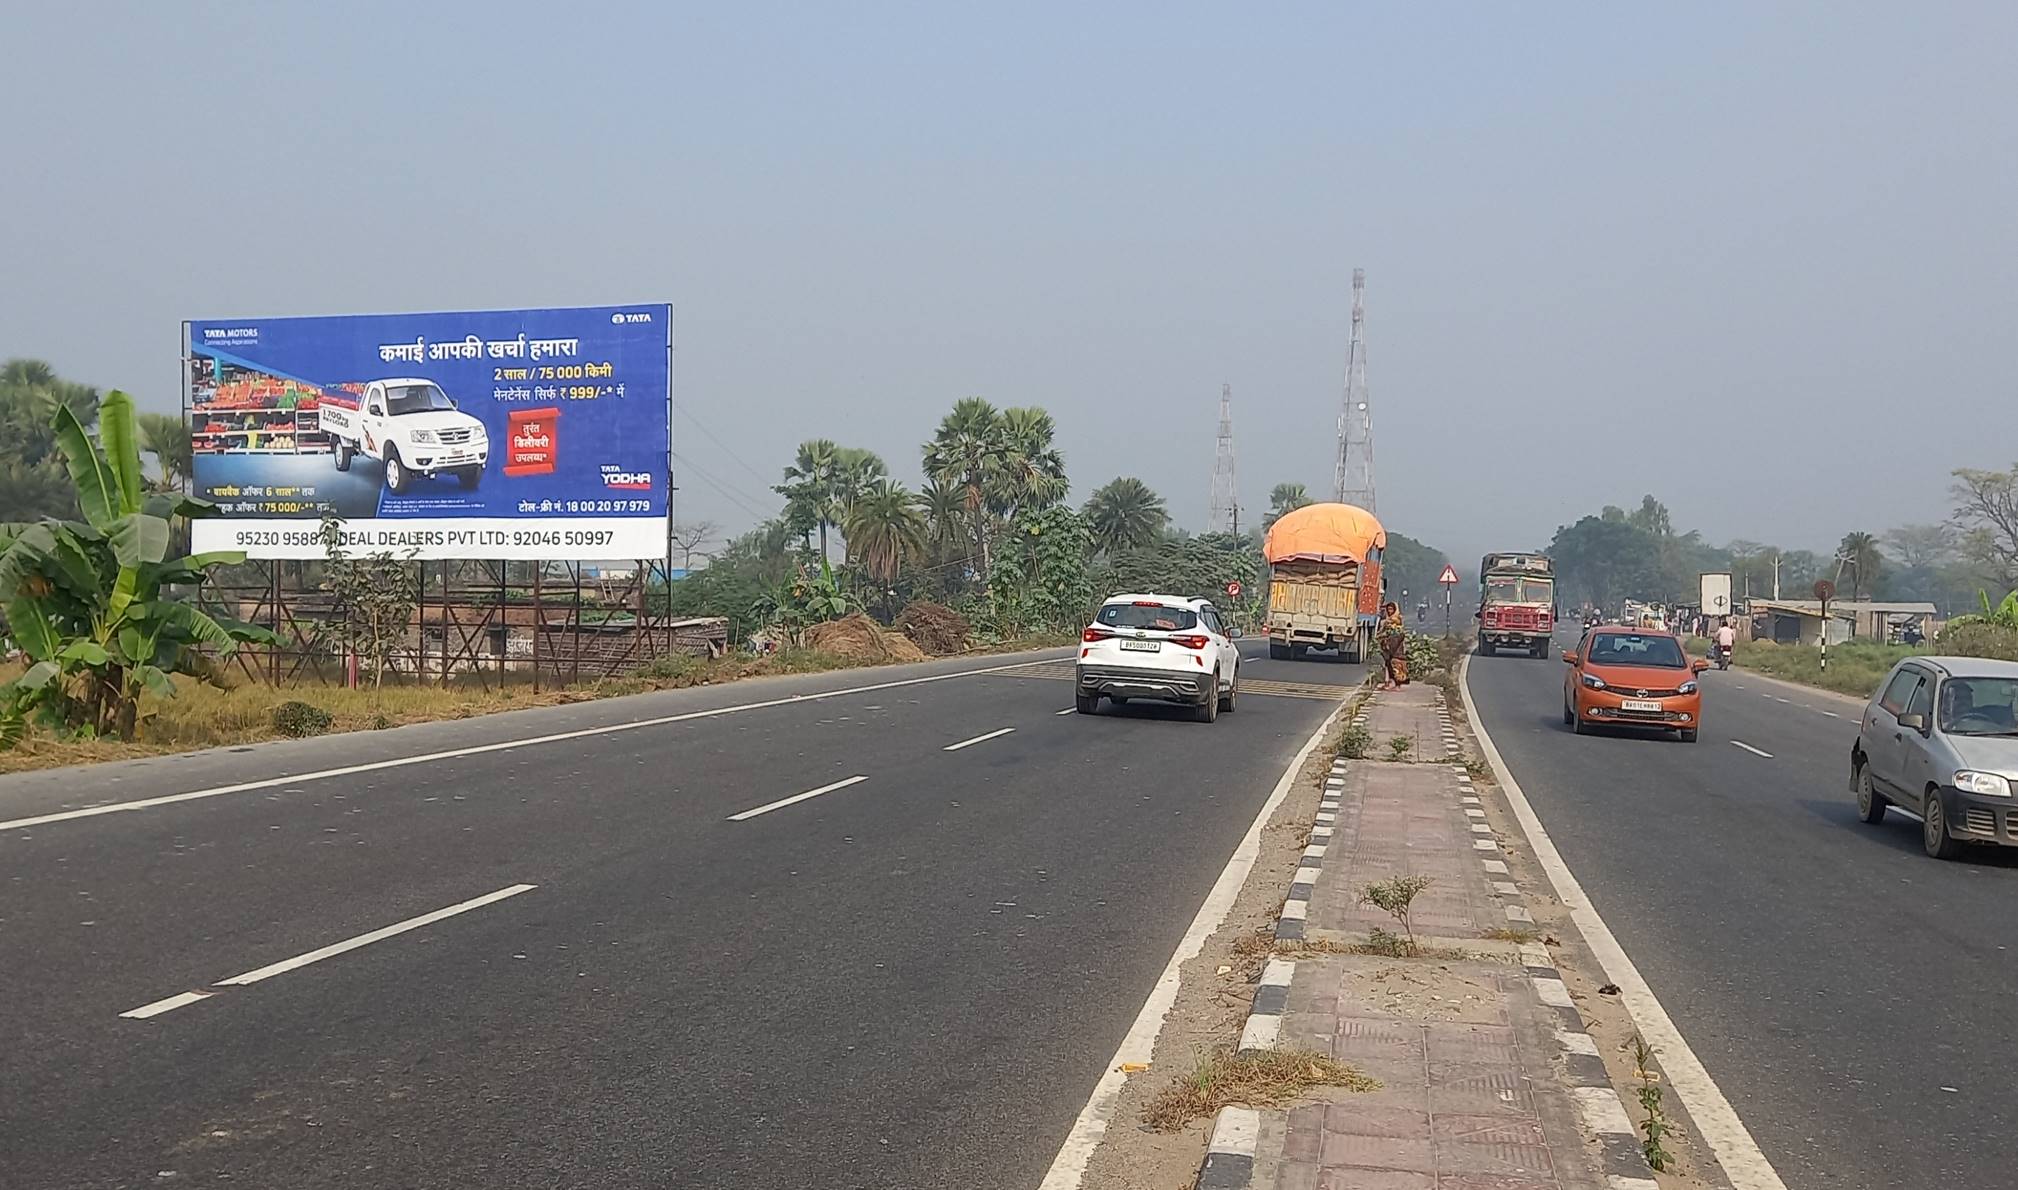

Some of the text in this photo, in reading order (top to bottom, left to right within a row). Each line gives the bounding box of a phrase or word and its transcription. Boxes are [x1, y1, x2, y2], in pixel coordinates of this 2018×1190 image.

[627, 313, 651, 322] TATA
[203, 328, 258, 338] TATA MOTORS
[378, 333, 579, 363] कमाई आपकी खर्चा हमारा
[494, 368, 501, 380] 2
[503, 368, 527, 380] साल
[585, 362, 612, 378] किमी
[534, 384, 556, 400] सिर्फ
[616, 383, 625, 398] में
[522, 422, 540, 437] तुरंत
[601, 473, 650, 484] YODHA
[242, 485, 263, 496] ऑफर
[266, 486, 273, 496] 6
[301, 486, 315, 496] तक
[235, 501, 256, 512] ऑफर
[236, 531, 279, 545] 95230
[378, 531, 444, 545] DEALERS
[448, 531, 476, 545] PVT
[479, 531, 510, 545] LTD:
[513, 531, 561, 546] 92046
[564, 531, 614, 546] 50997
